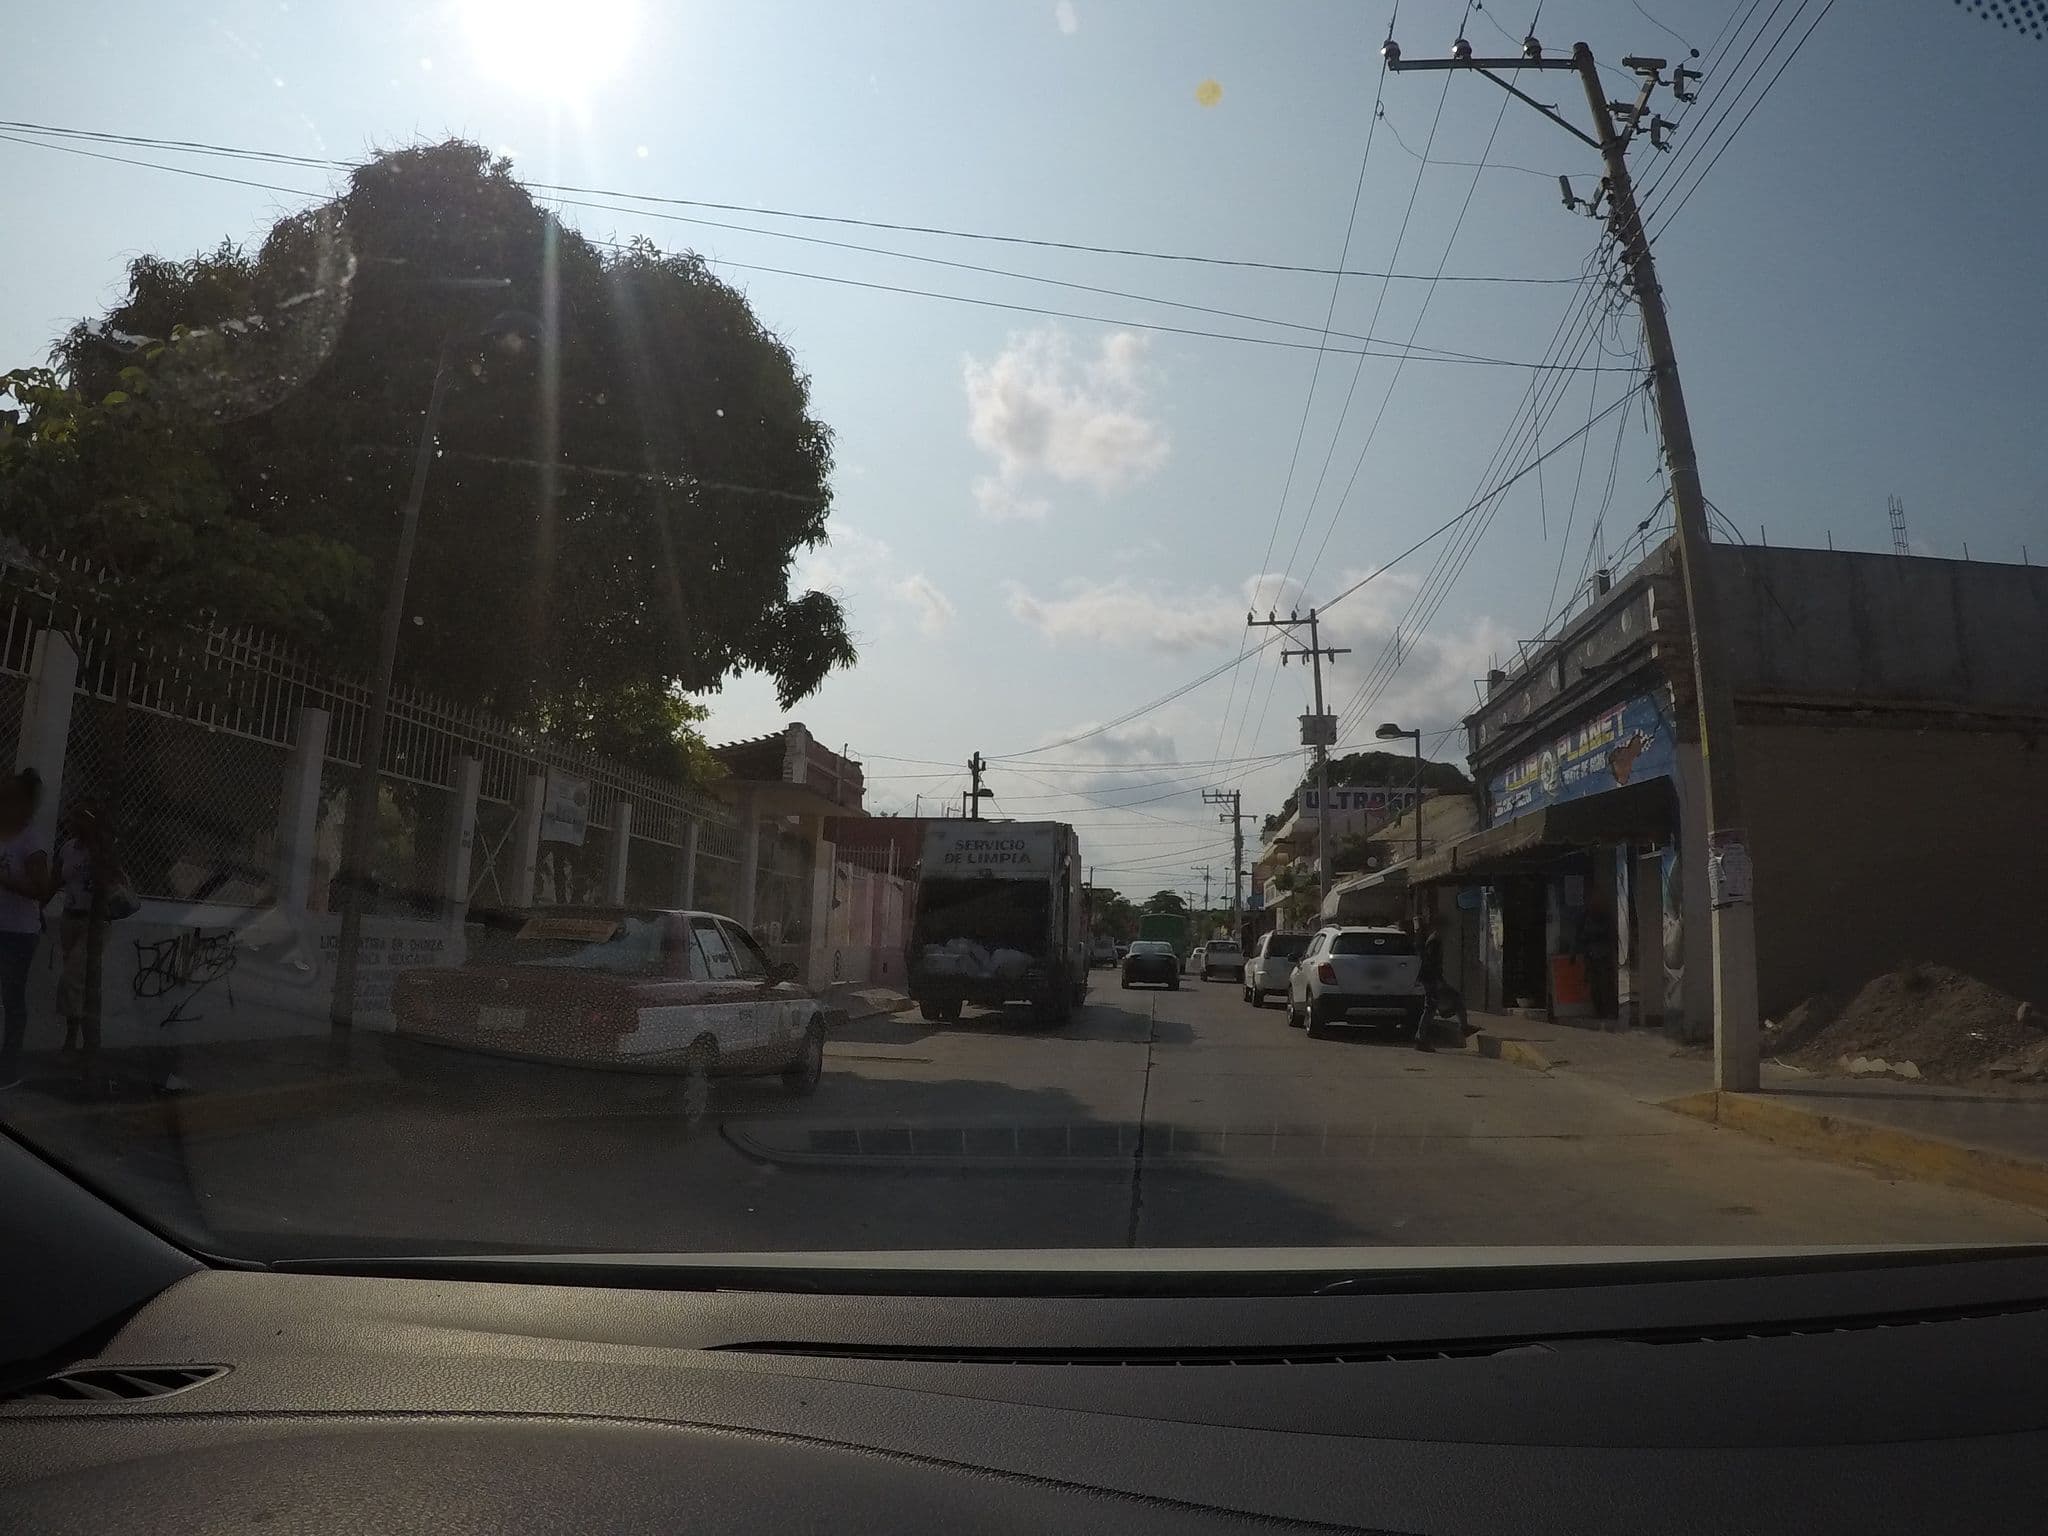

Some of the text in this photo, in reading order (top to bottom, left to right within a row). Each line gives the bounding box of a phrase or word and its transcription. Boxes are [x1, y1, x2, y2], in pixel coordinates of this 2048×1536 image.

[1554, 701, 1628, 763] PLANET
[955, 839, 1026, 851] SERVICIO
[944, 852, 1032, 864] DE LIMPIA
